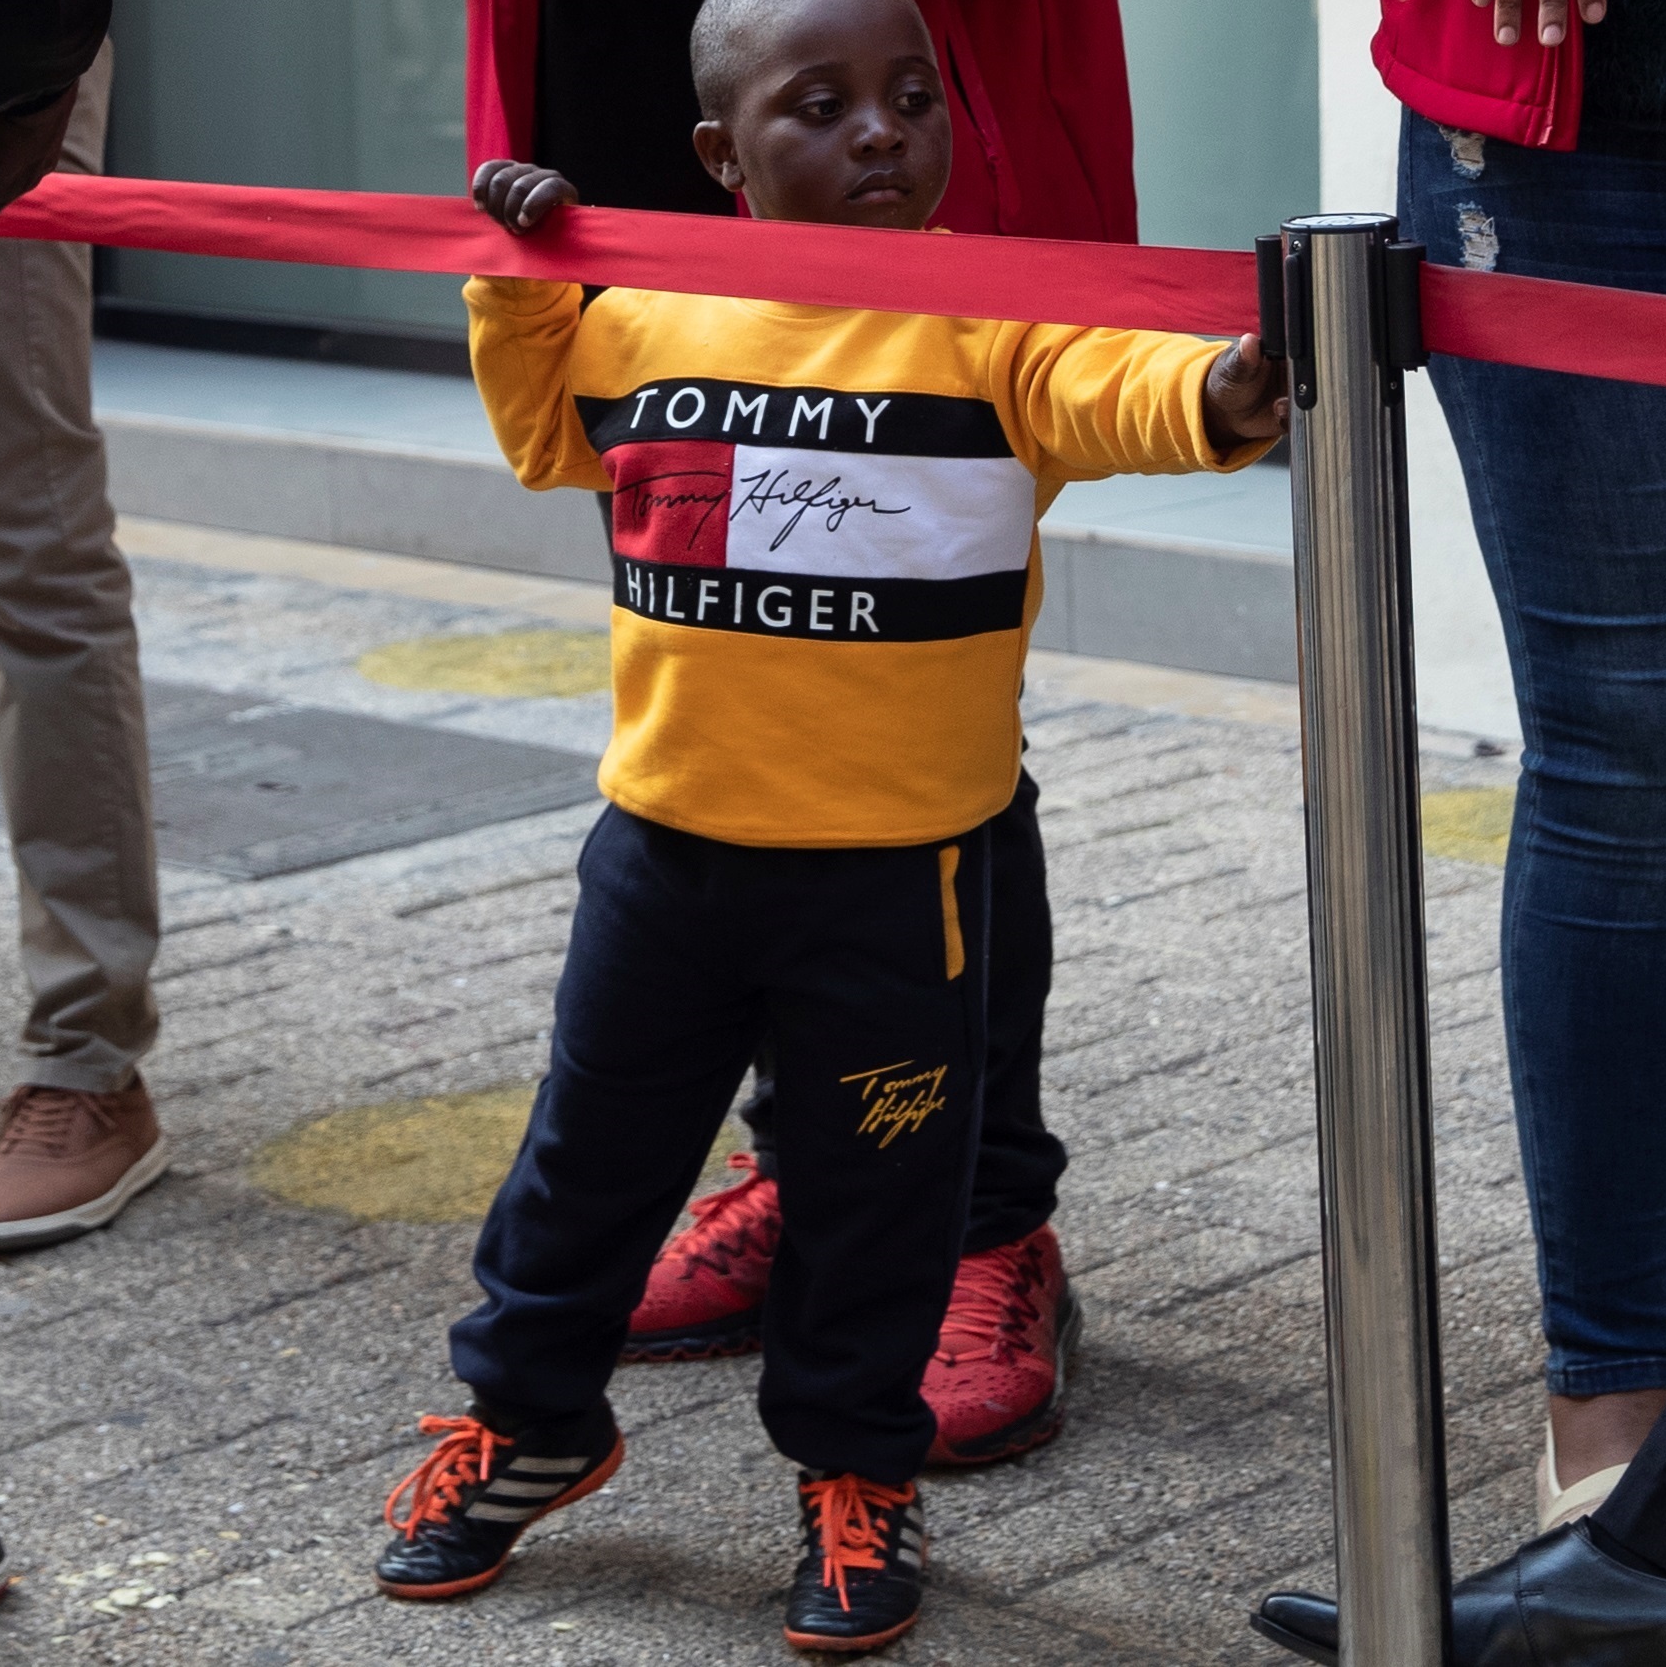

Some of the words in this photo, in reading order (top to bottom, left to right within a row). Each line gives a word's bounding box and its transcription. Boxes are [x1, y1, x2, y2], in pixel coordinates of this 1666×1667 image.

[630, 387, 891, 444] TOMMY
[614, 470, 732, 550] Tommy
[729, 468, 912, 552] Hilfiger
[624, 562, 880, 633] HILFIGER
[839, 1059, 949, 1101] Tommy
